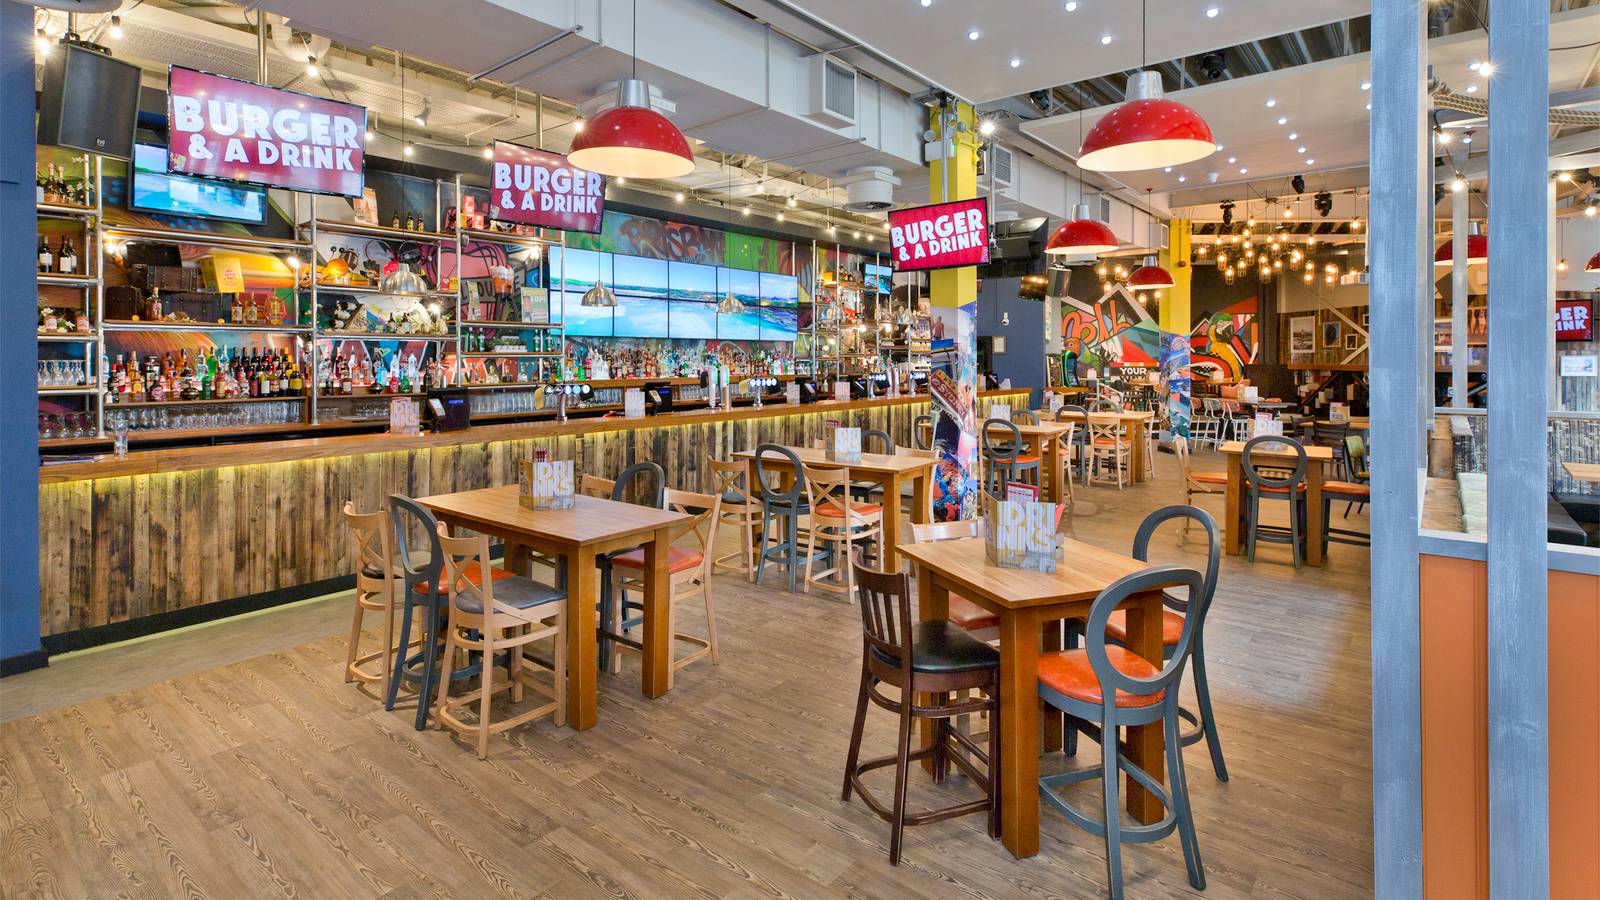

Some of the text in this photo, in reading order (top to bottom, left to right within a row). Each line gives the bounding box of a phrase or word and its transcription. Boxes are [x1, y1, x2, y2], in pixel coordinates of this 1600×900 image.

[173, 95, 360, 149] BURGER
[188, 133, 355, 171] & A DRINK
[494, 162, 602, 197] BURGER
[500, 189, 598, 214] & A DRINK
[891, 208, 985, 248] BURGER
[899, 246, 911, 261] &
[914, 243, 926, 259] A
[928, 230, 983, 256] DRINK
[1119, 367, 1147, 375] YOUR
